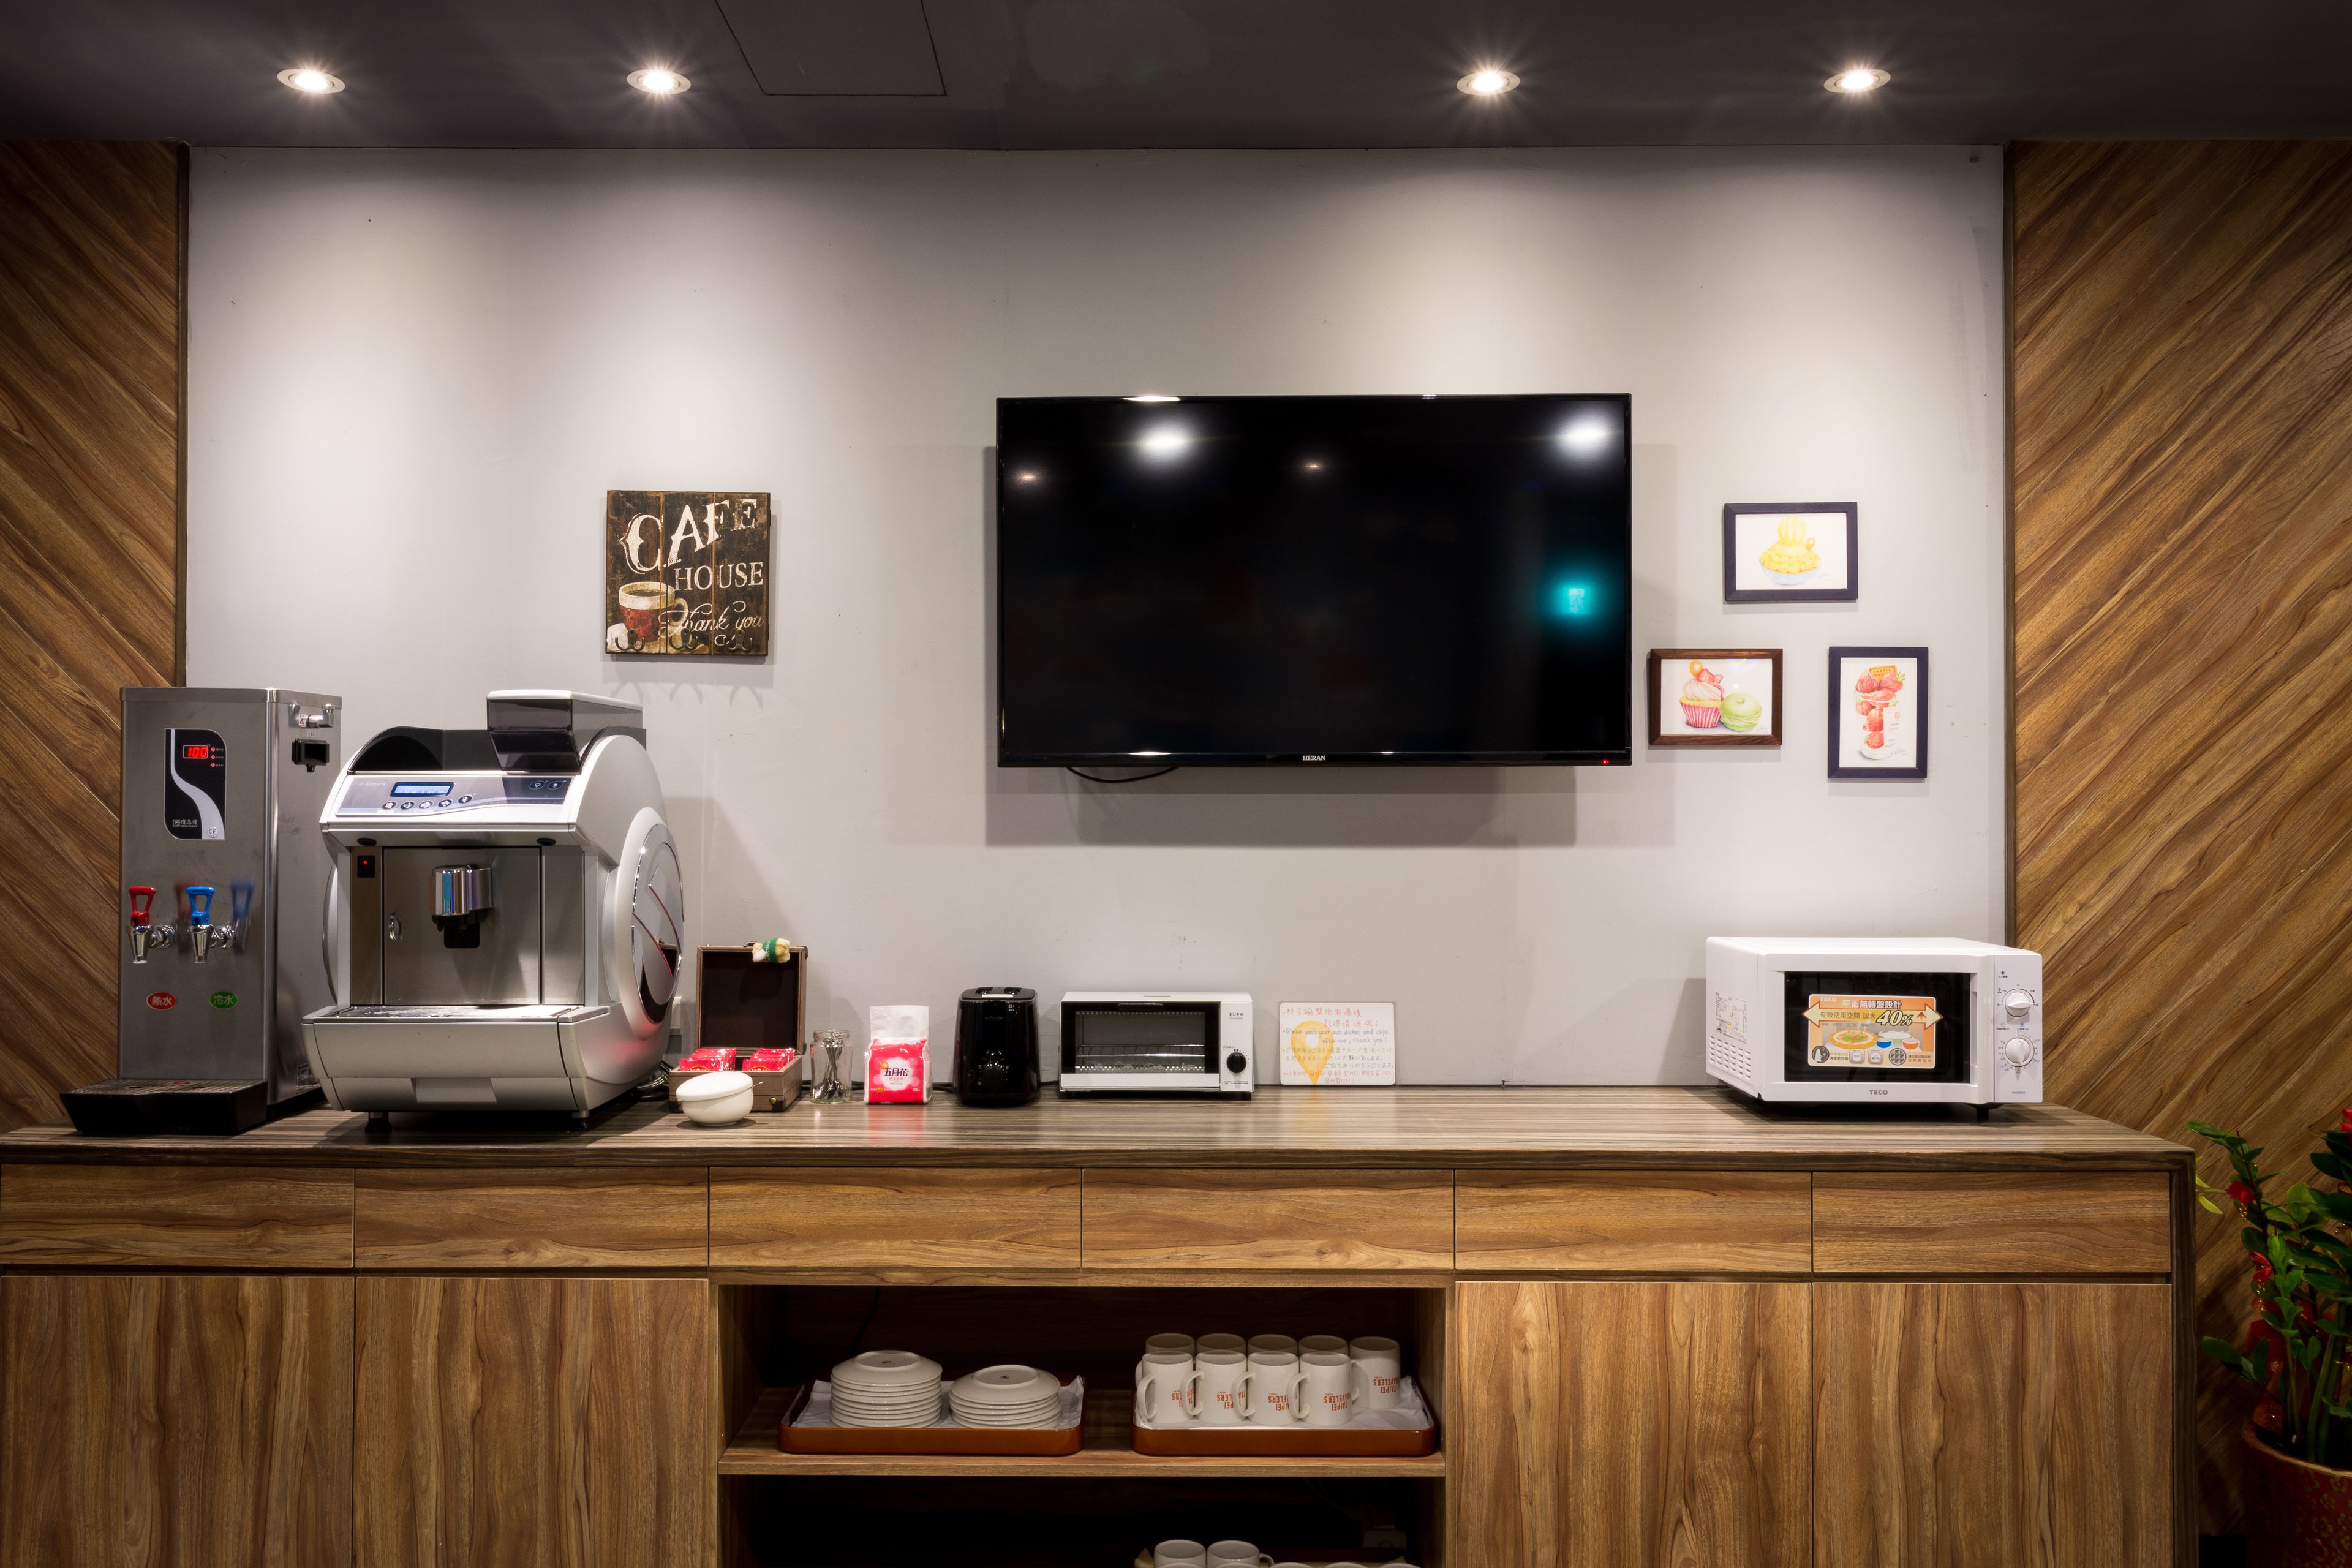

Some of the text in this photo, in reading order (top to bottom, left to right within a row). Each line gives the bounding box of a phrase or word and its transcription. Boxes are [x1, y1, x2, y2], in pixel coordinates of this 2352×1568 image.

[618, 499, 756, 575] CAFE
[674, 562, 764, 590] HOUSE
[658, 601, 730, 638] Thank
[188, 747, 208, 758] 100
[152, 995, 172, 1006] 熱水
[213, 995, 234, 1005] 冷水
[1842, 999, 1902, 1009] 平面無轉盤設計
[1875, 1009, 1913, 1026] 40%
[1318, 1030, 1330, 1038] your
[1376, 1028, 1389, 1037] cups
[1373, 1037, 1387, 1046] you!
[884, 1068, 908, 1077] 五月花
[1332, 1401, 1348, 1411] TAIPEI
